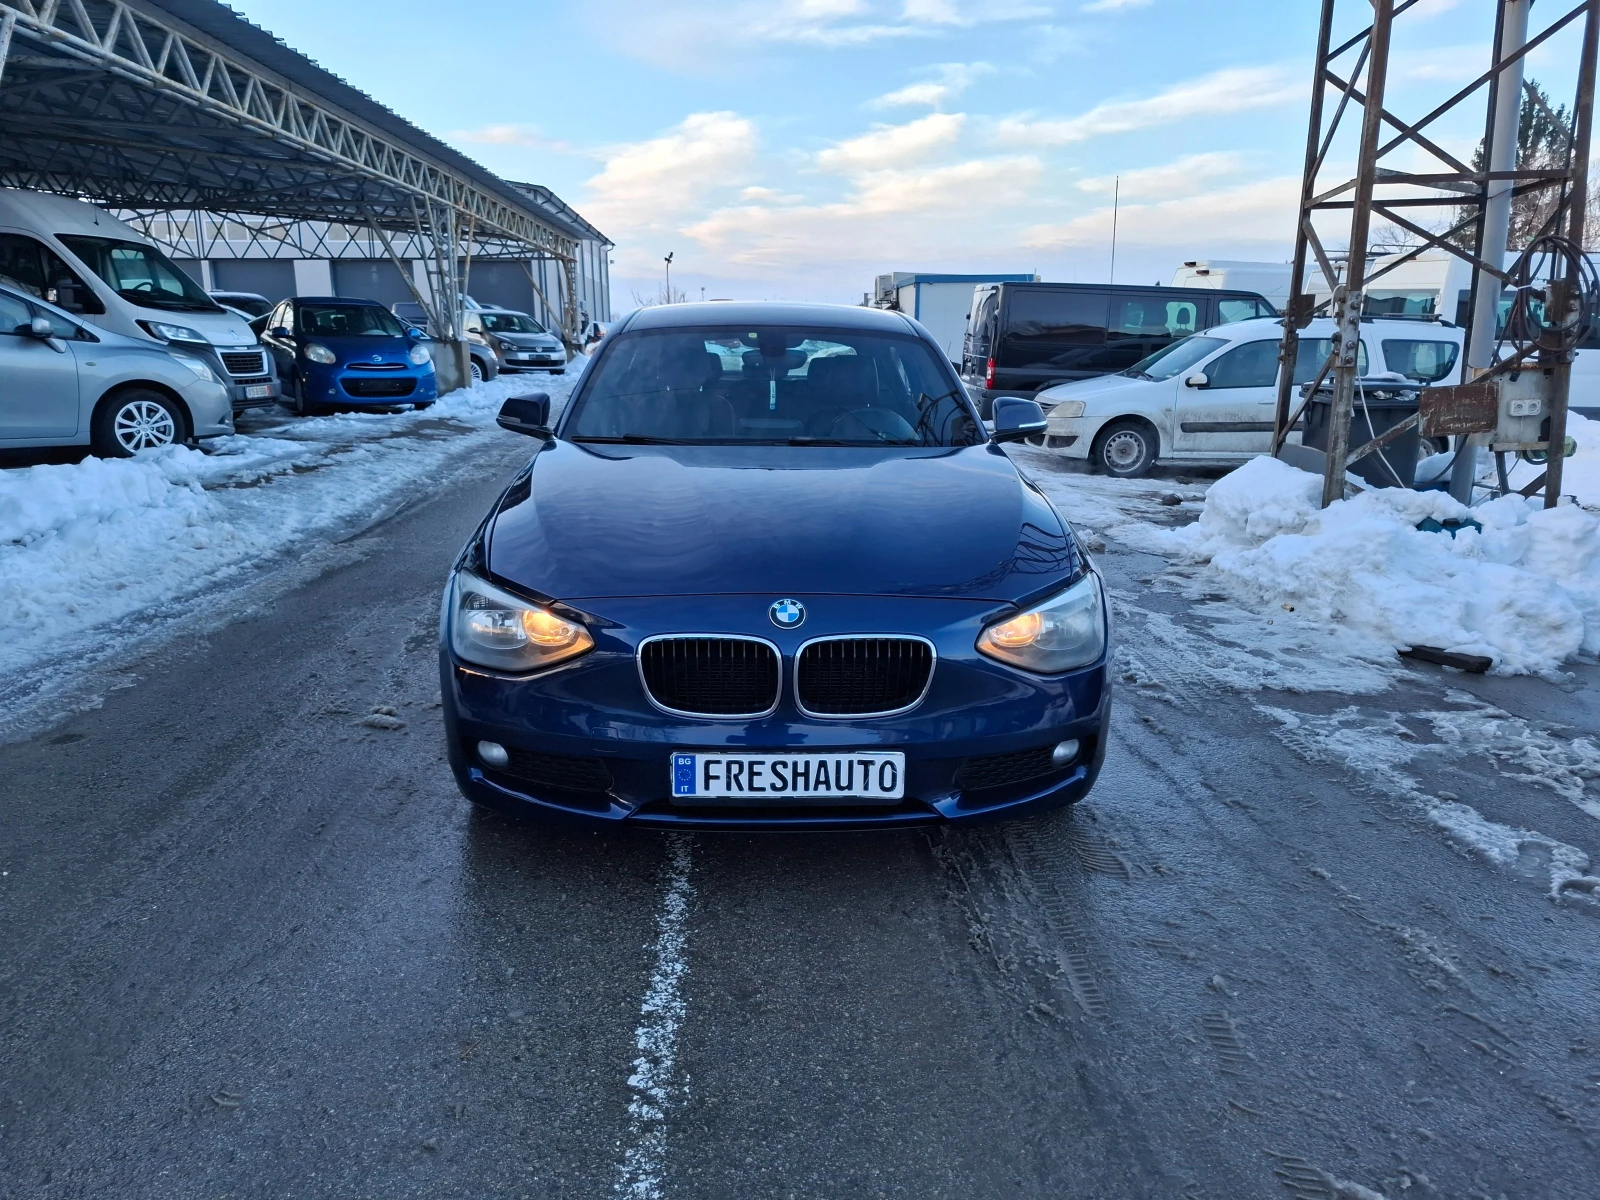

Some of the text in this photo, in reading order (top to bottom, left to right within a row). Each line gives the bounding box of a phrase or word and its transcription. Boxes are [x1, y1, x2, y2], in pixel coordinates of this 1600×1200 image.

[678, 757, 692, 765] BG
[703, 759, 898, 793] FRESHAUTO
[680, 785, 690, 793] IT
